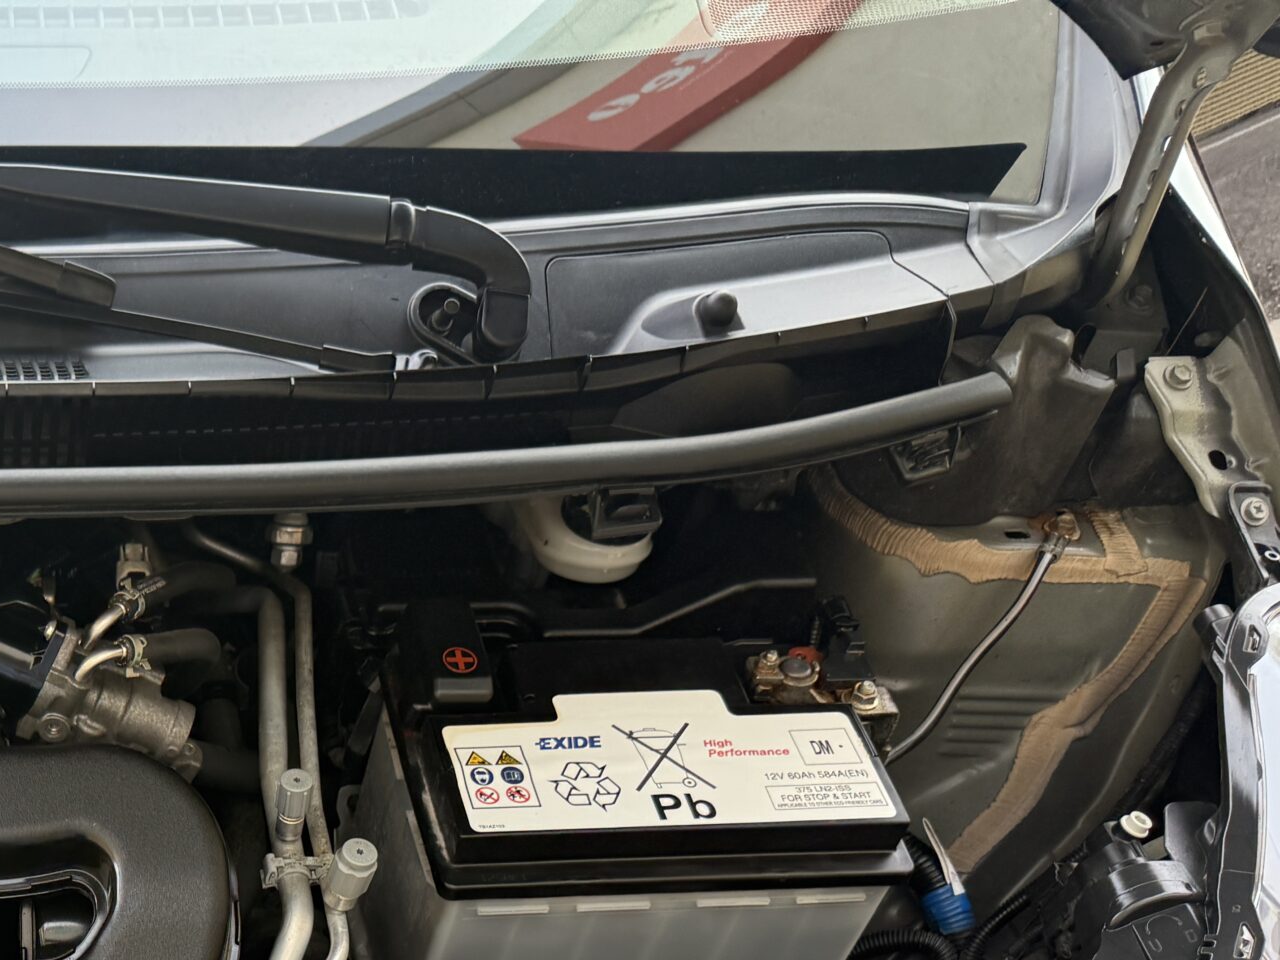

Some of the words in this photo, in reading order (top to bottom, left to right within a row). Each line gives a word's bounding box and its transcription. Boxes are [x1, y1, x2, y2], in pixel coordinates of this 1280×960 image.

[536, 735, 602, 750] EXIDE
[703, 739, 733, 749] High
[809, 740, 834, 755] DM
[708, 747, 790, 758] Performance
[764, 772, 784, 781] 12V
[781, 794, 802, 803] FOR
[804, 793, 830, 802] STOP
[841, 791, 871, 800] START
[651, 793, 718, 820] Pb
